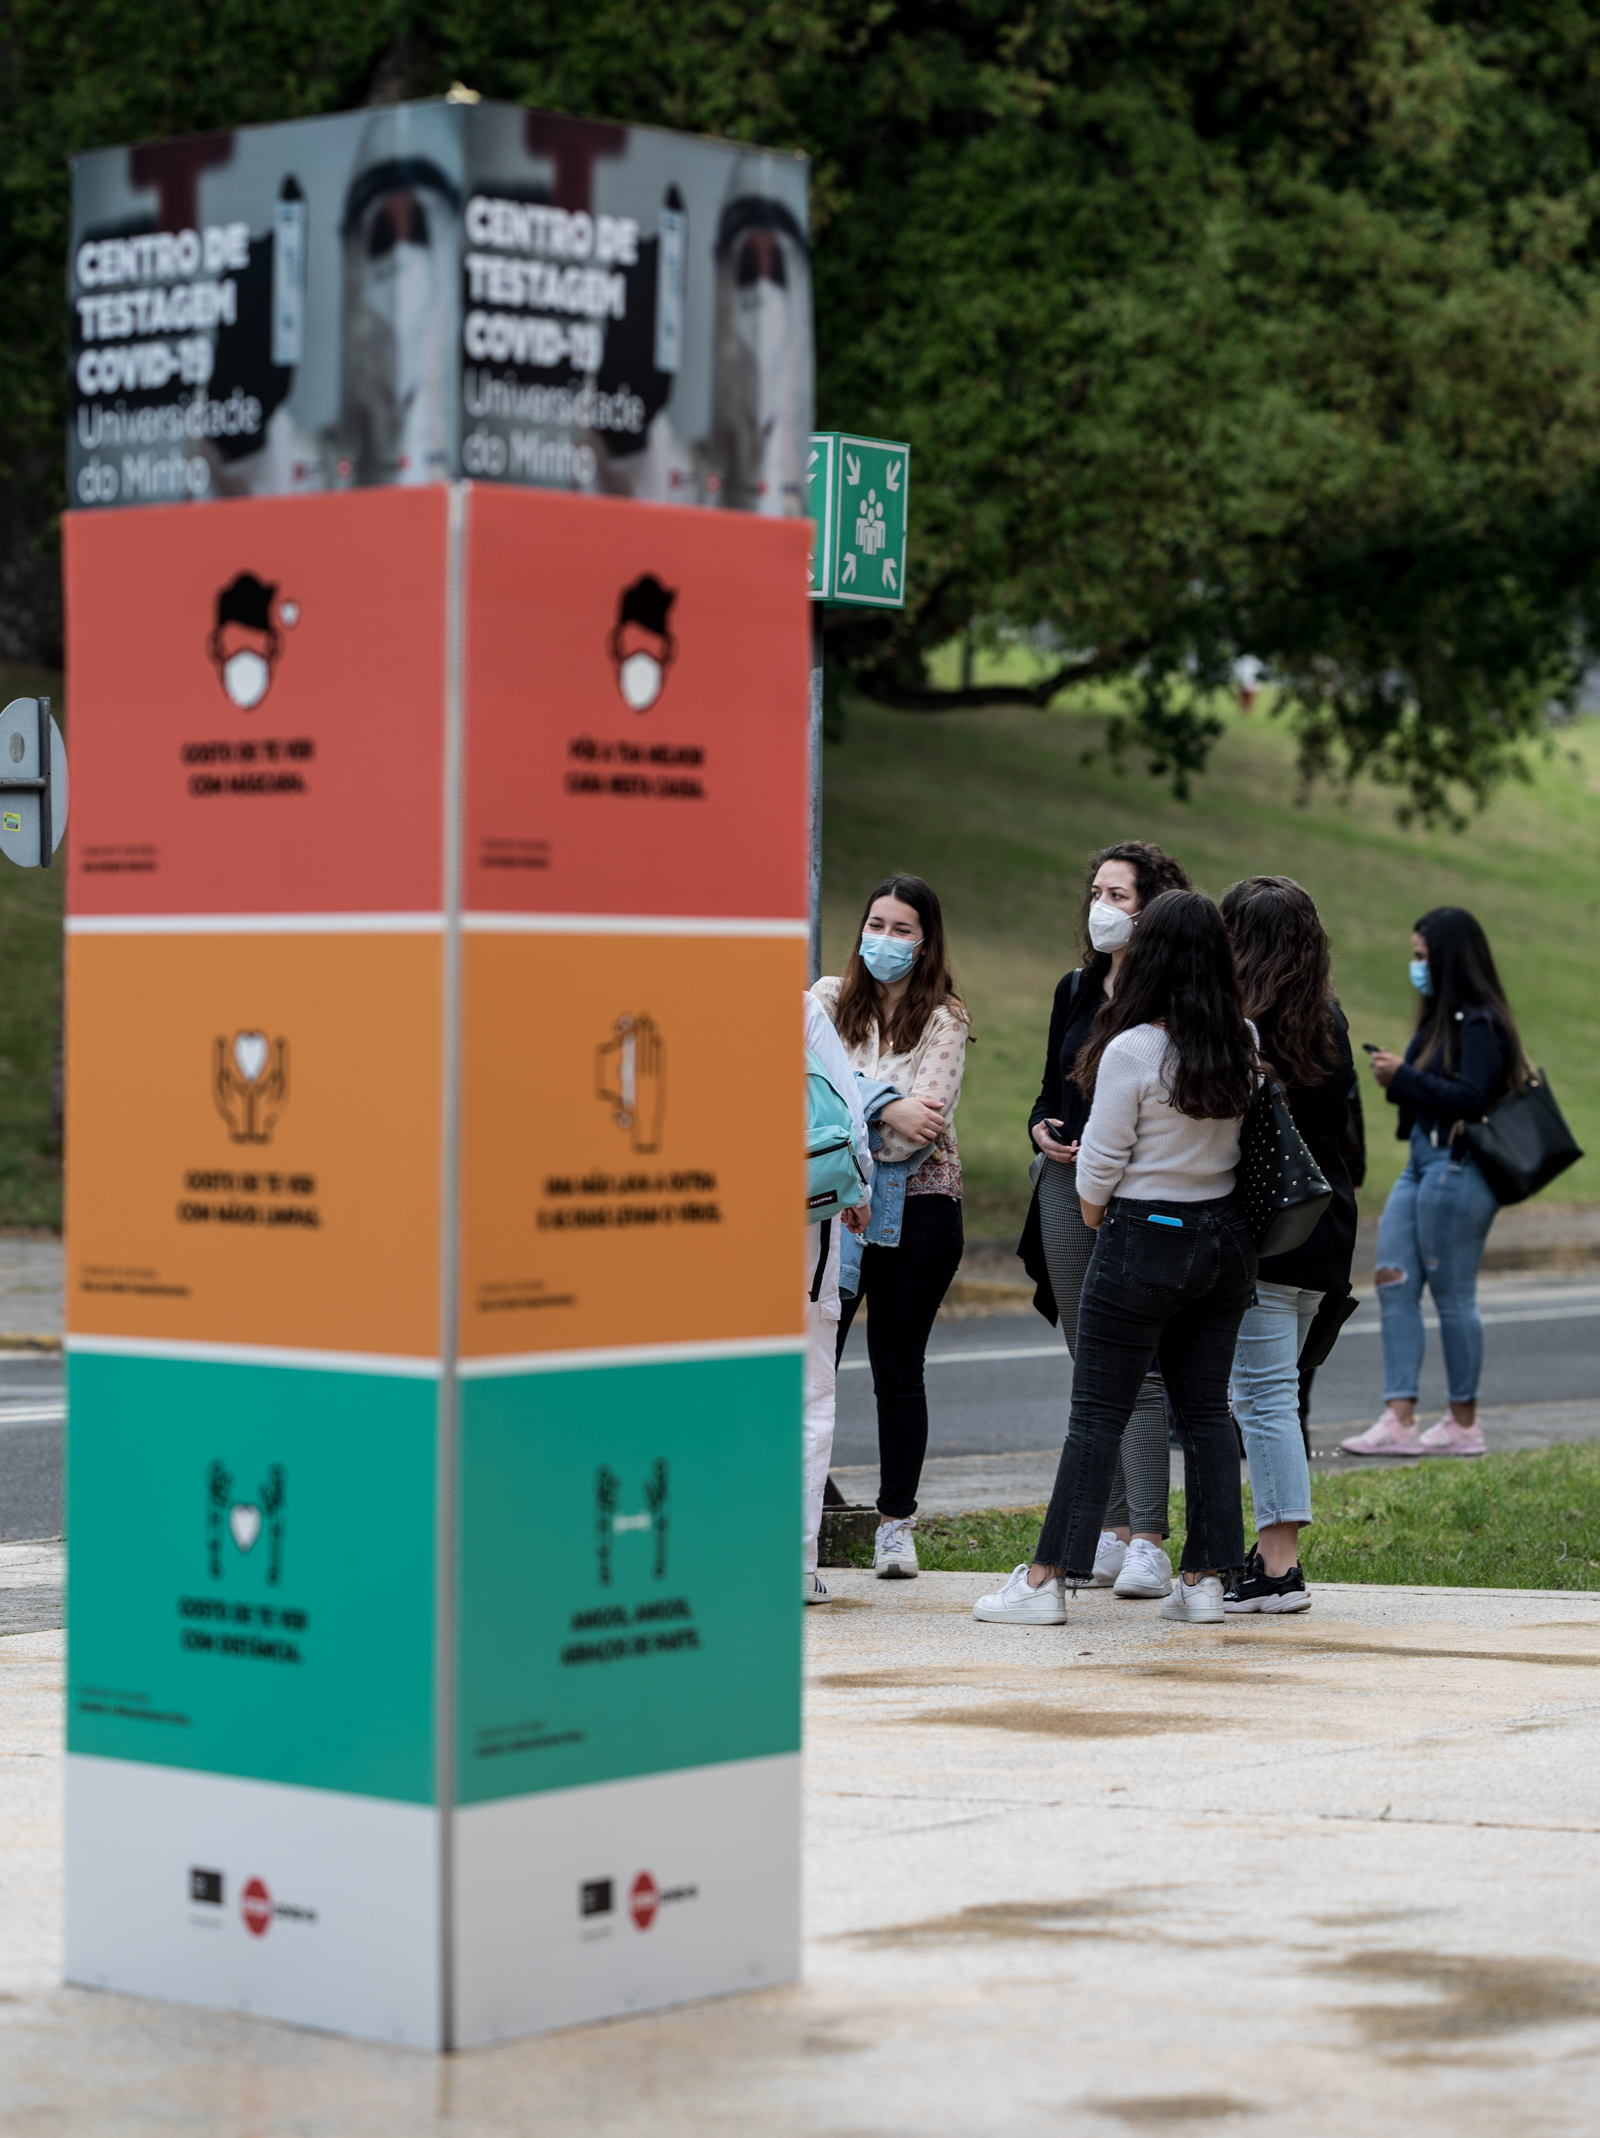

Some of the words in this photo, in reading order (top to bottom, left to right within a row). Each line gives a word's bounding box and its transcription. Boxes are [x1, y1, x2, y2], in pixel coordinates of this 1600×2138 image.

[76, 228, 201, 289] CENTRO
[202, 221, 250, 273] DE
[465, 195, 594, 258] CENTRO
[595, 212, 639, 266] DE
[76, 278, 238, 342] TESTAGEM
[465, 252, 627, 320] TESTAGEM
[76, 336, 214, 396] COVID-19
[465, 309, 602, 373] COVID-19
[77, 386, 262, 451] Universidade
[463, 367, 646, 434] Universidade
[76, 452, 119, 503] do
[121, 446, 212, 497] Minho
[462, 422, 508, 475] do
[510, 429, 597, 486] Minho
